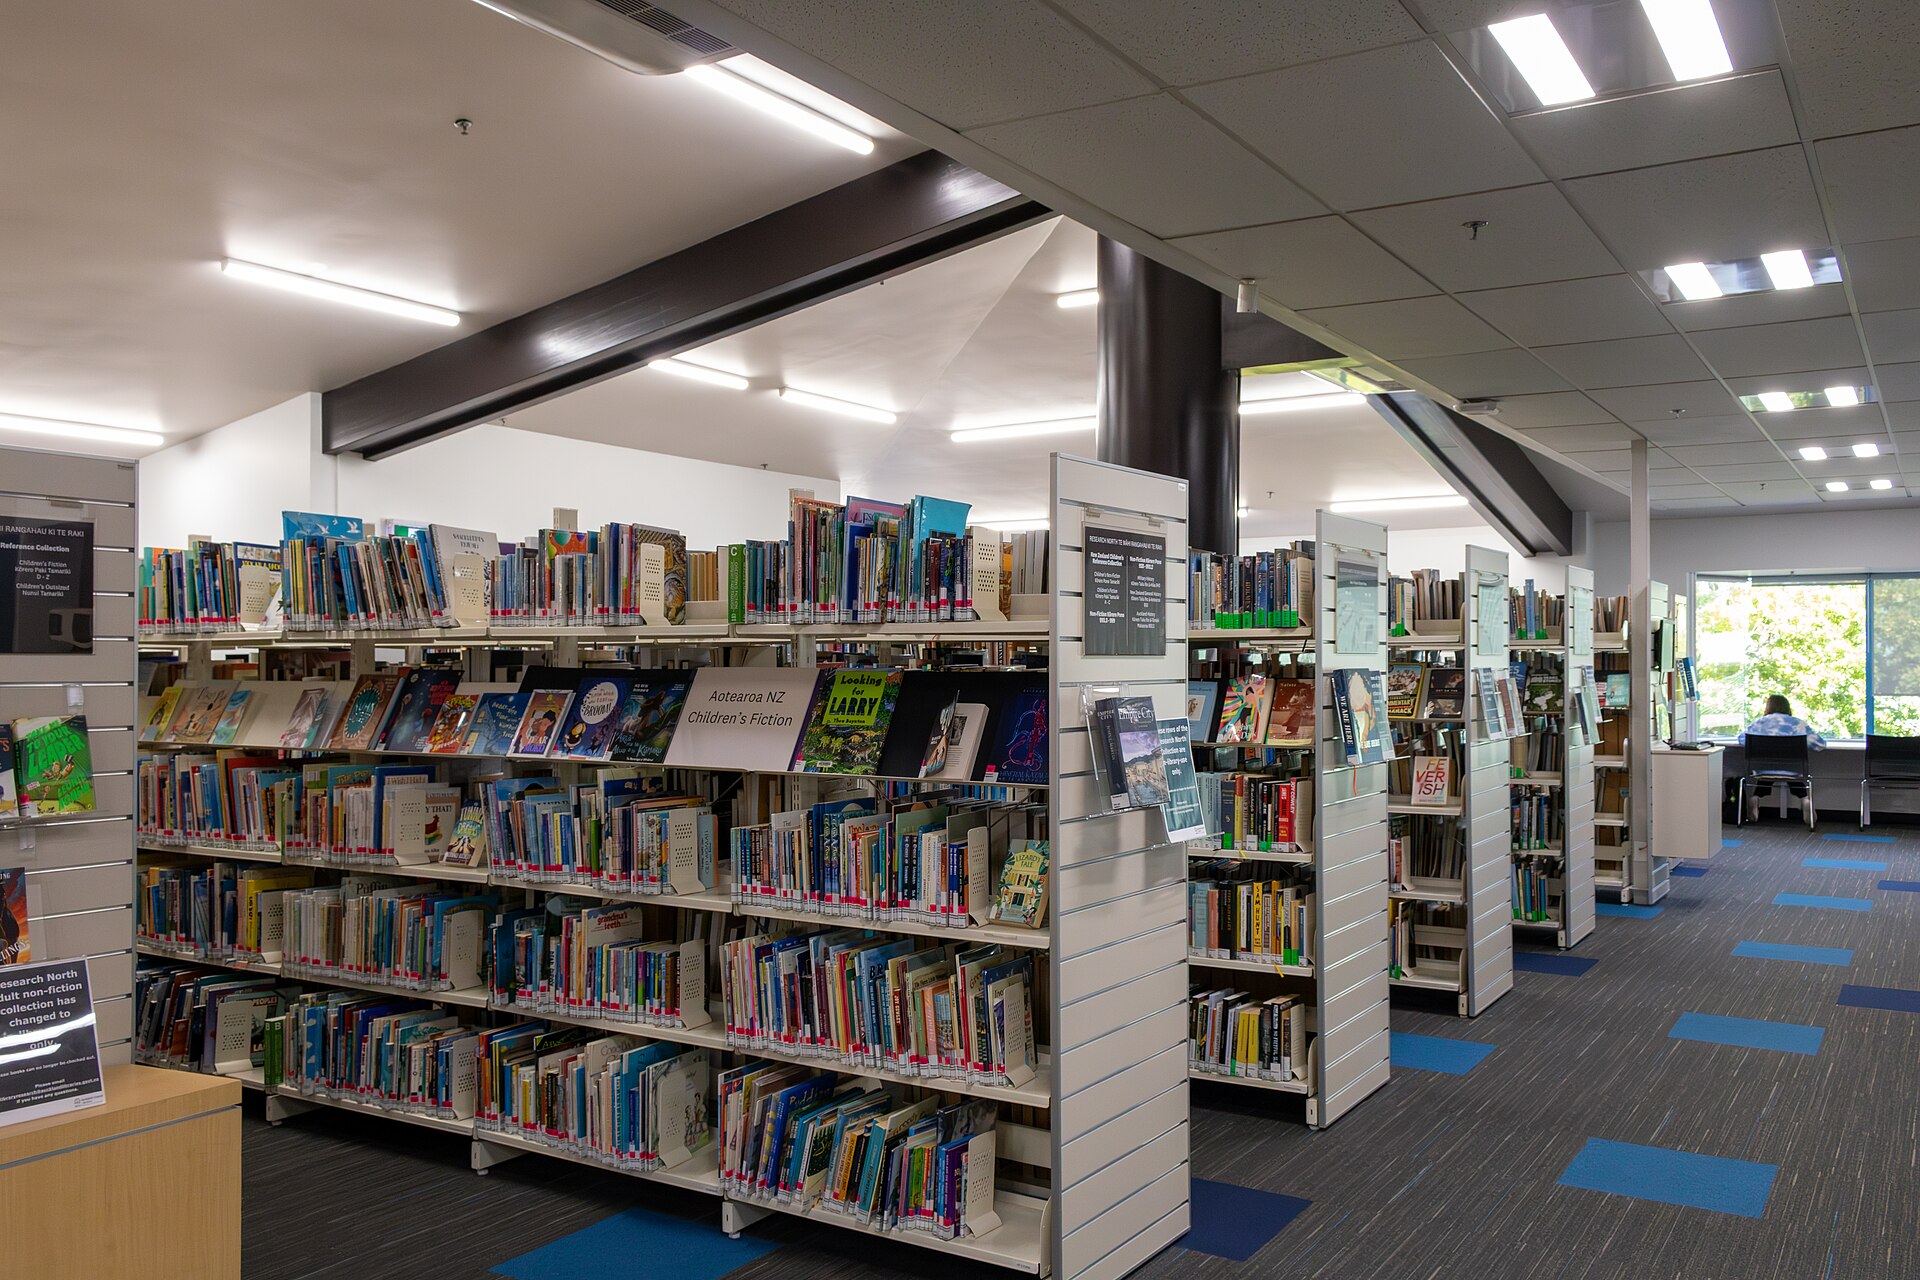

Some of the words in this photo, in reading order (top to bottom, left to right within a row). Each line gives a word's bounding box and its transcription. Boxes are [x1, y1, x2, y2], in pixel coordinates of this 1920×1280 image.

[5, 525, 47, 535] RANGAHAU
[48, 528, 56, 536] KI
[57, 529, 66, 537] TE
[67, 530, 85, 538] RAKI
[0, 542, 35, 551] Reference
[36, 544, 70, 553] Collection
[840, 673, 883, 687] Looking
[708, 689, 763, 703] Aotearoa
[765, 691, 786, 704] NZ
[851, 686, 865, 696] for
[829, 696, 879, 716] LARRY
[687, 710, 748, 725] Children's
[749, 712, 793, 727] Fiction
[1340, 695, 1347, 708] WE
[1344, 724, 1354, 745] HERE
[26, 739, 41, 754] TO
[41, 725, 73, 748] YOUR
[27, 733, 87, 778] LEADER
[1426, 757, 1448, 770] FE
[1416, 770, 1446, 783] VER
[1418, 783, 1445, 796] ISH
[1254, 885, 1262, 906] SAM
[604, 921, 622, 930] teeth
[0, 974, 44, 989] esearch
[46, 969, 79, 982] North
[0, 991, 21, 1002] dult
[22, 982, 83, 999] non-fiction
[0, 1000, 54, 1016] collection
[56, 996, 77, 1006] has
[9, 1011, 57, 1027] changed
[58, 1010, 71, 1019] to
